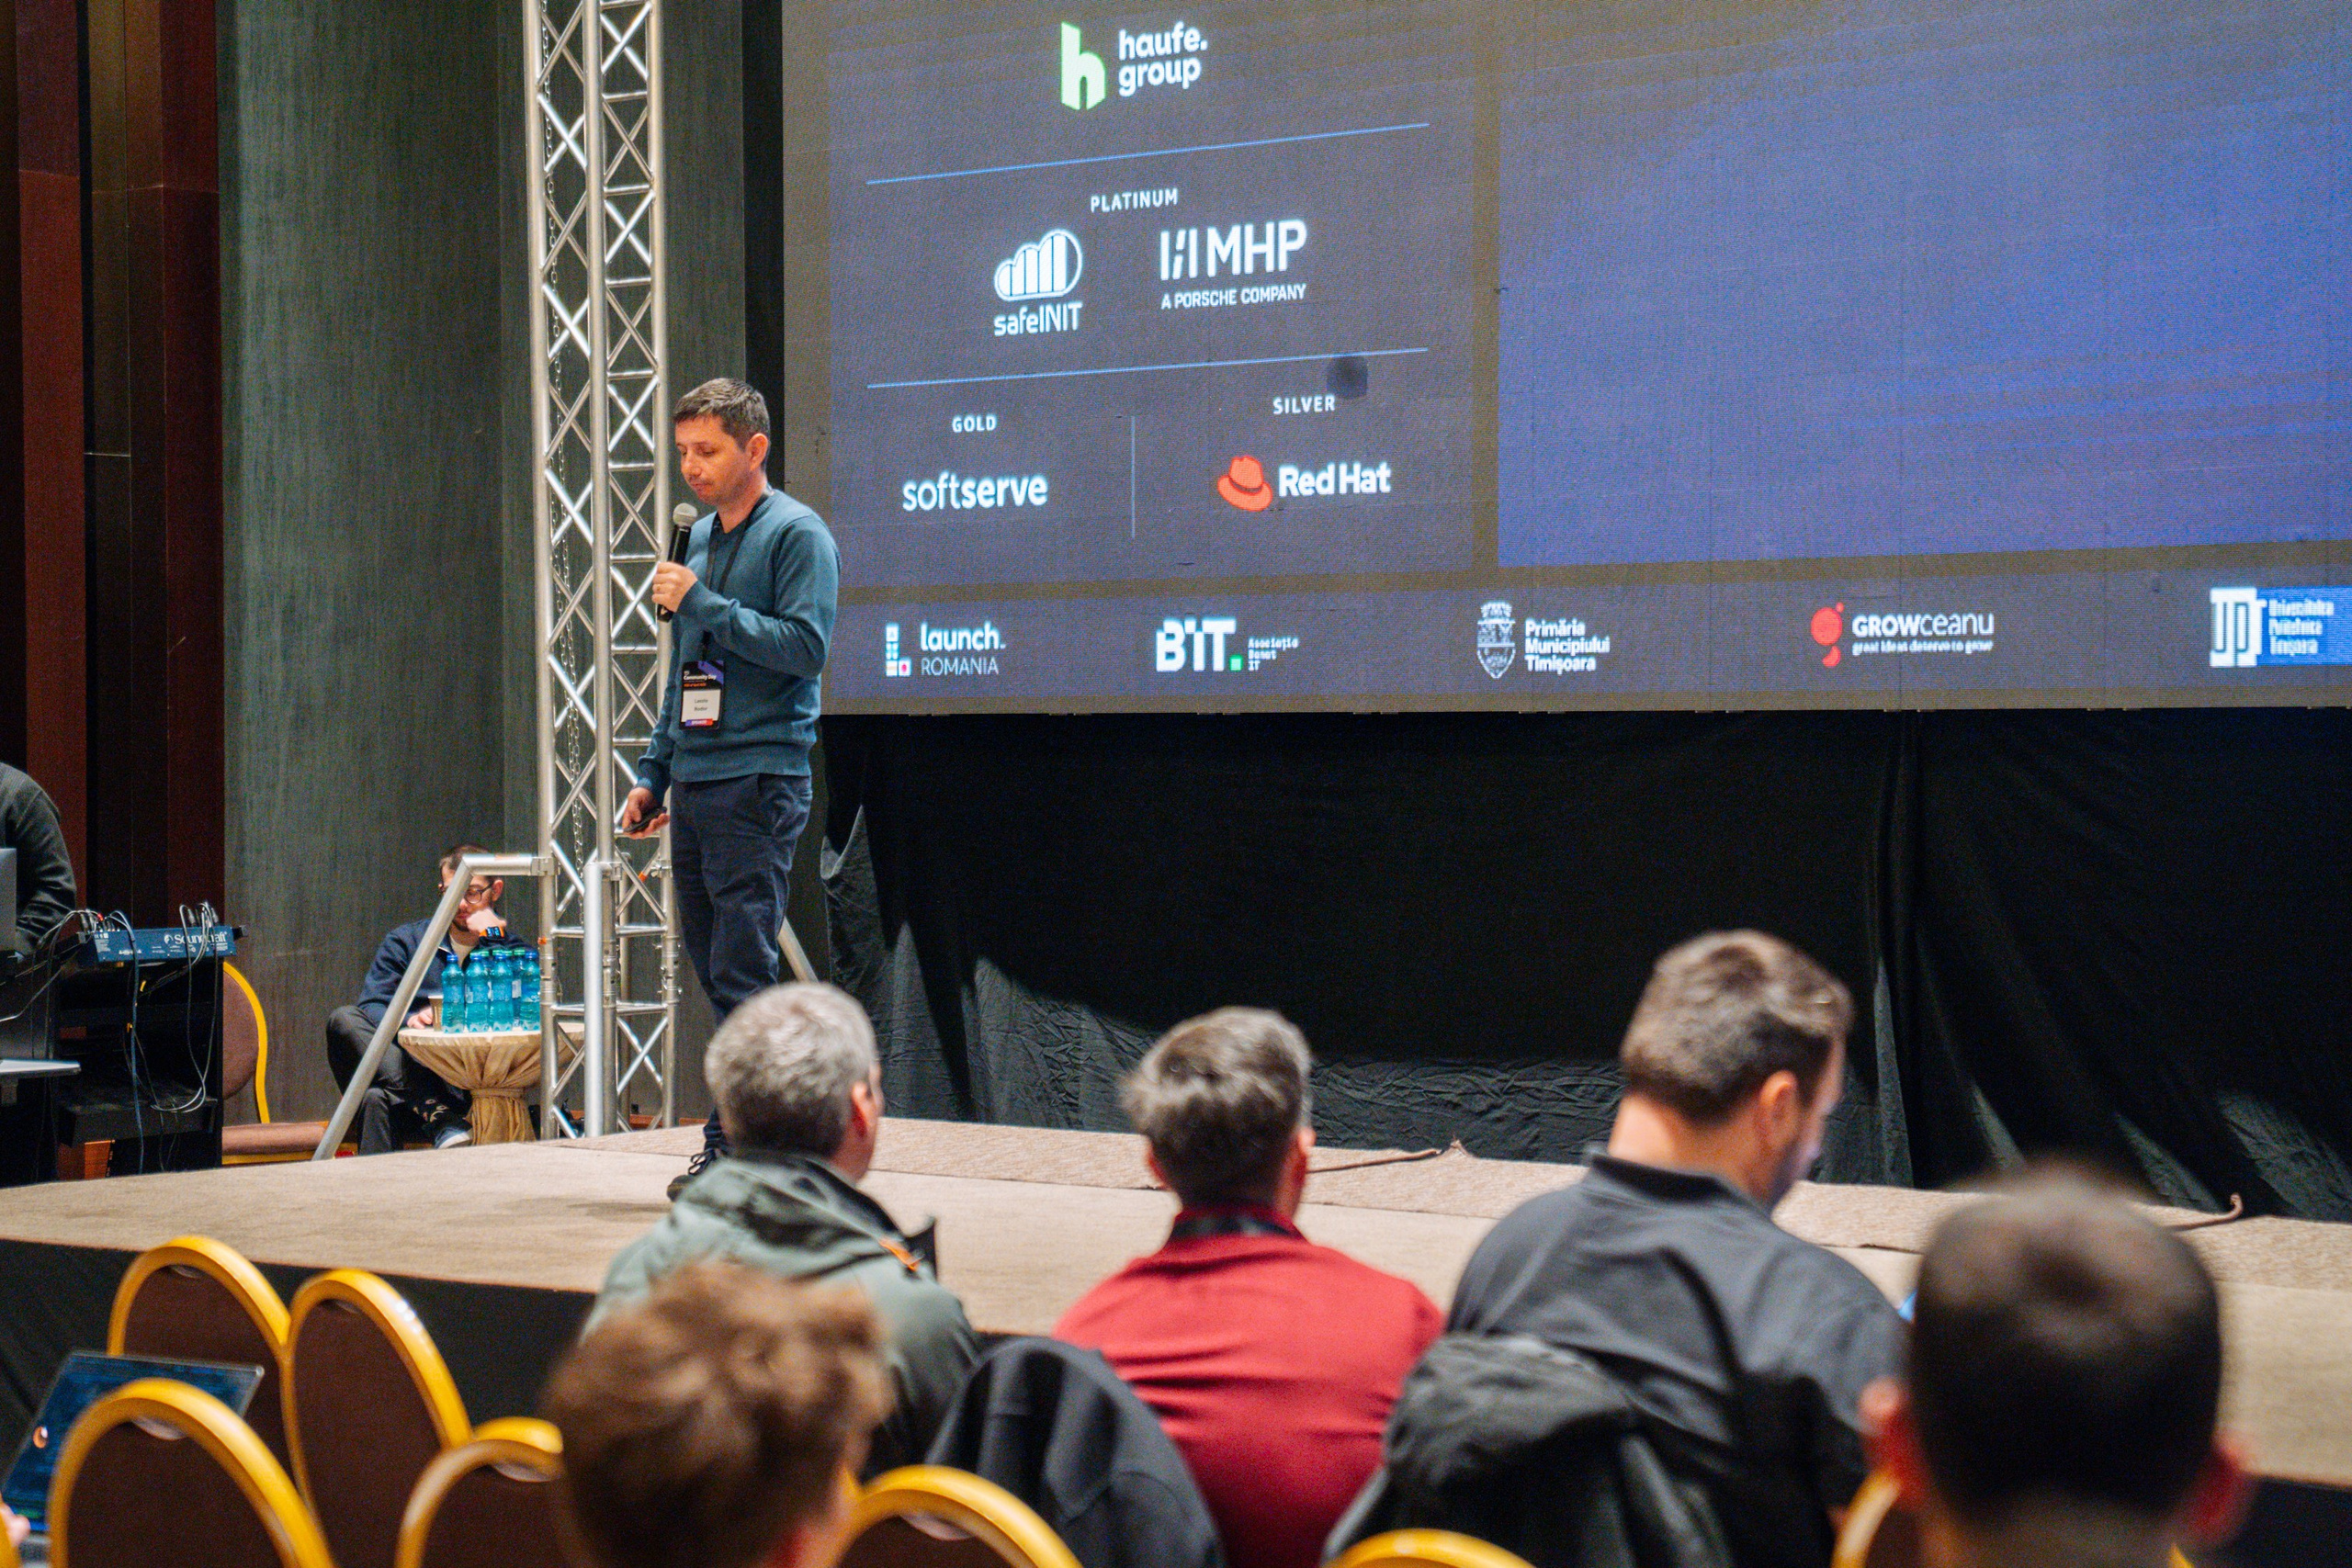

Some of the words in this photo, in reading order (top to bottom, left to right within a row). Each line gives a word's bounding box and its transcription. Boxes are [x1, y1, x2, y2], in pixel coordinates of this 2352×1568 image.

[1118, 20, 1208, 59] haufe.
[1118, 57, 1202, 97] group
[1090, 187, 1179, 213] PLATINUM
[1206, 219, 1308, 277] MHP
[1160, 292, 1172, 310] A
[1173, 288, 1238, 309] PORSCHE
[1239, 283, 1307, 305] COMPANY
[993, 301, 1083, 337] safeINIT
[1272, 394, 1336, 415] SILVER
[951, 413, 998, 434] GOLD
[902, 470, 1048, 512] softserve
[1278, 464, 1336, 498] Red
[1338, 461, 1392, 495] Hat
[920, 621, 1007, 652] launch.
[1851, 613, 1995, 637] GROWceanu
[1524, 635, 1611, 656] Municipiului
[921, 656, 1000, 676] ROMANIA
